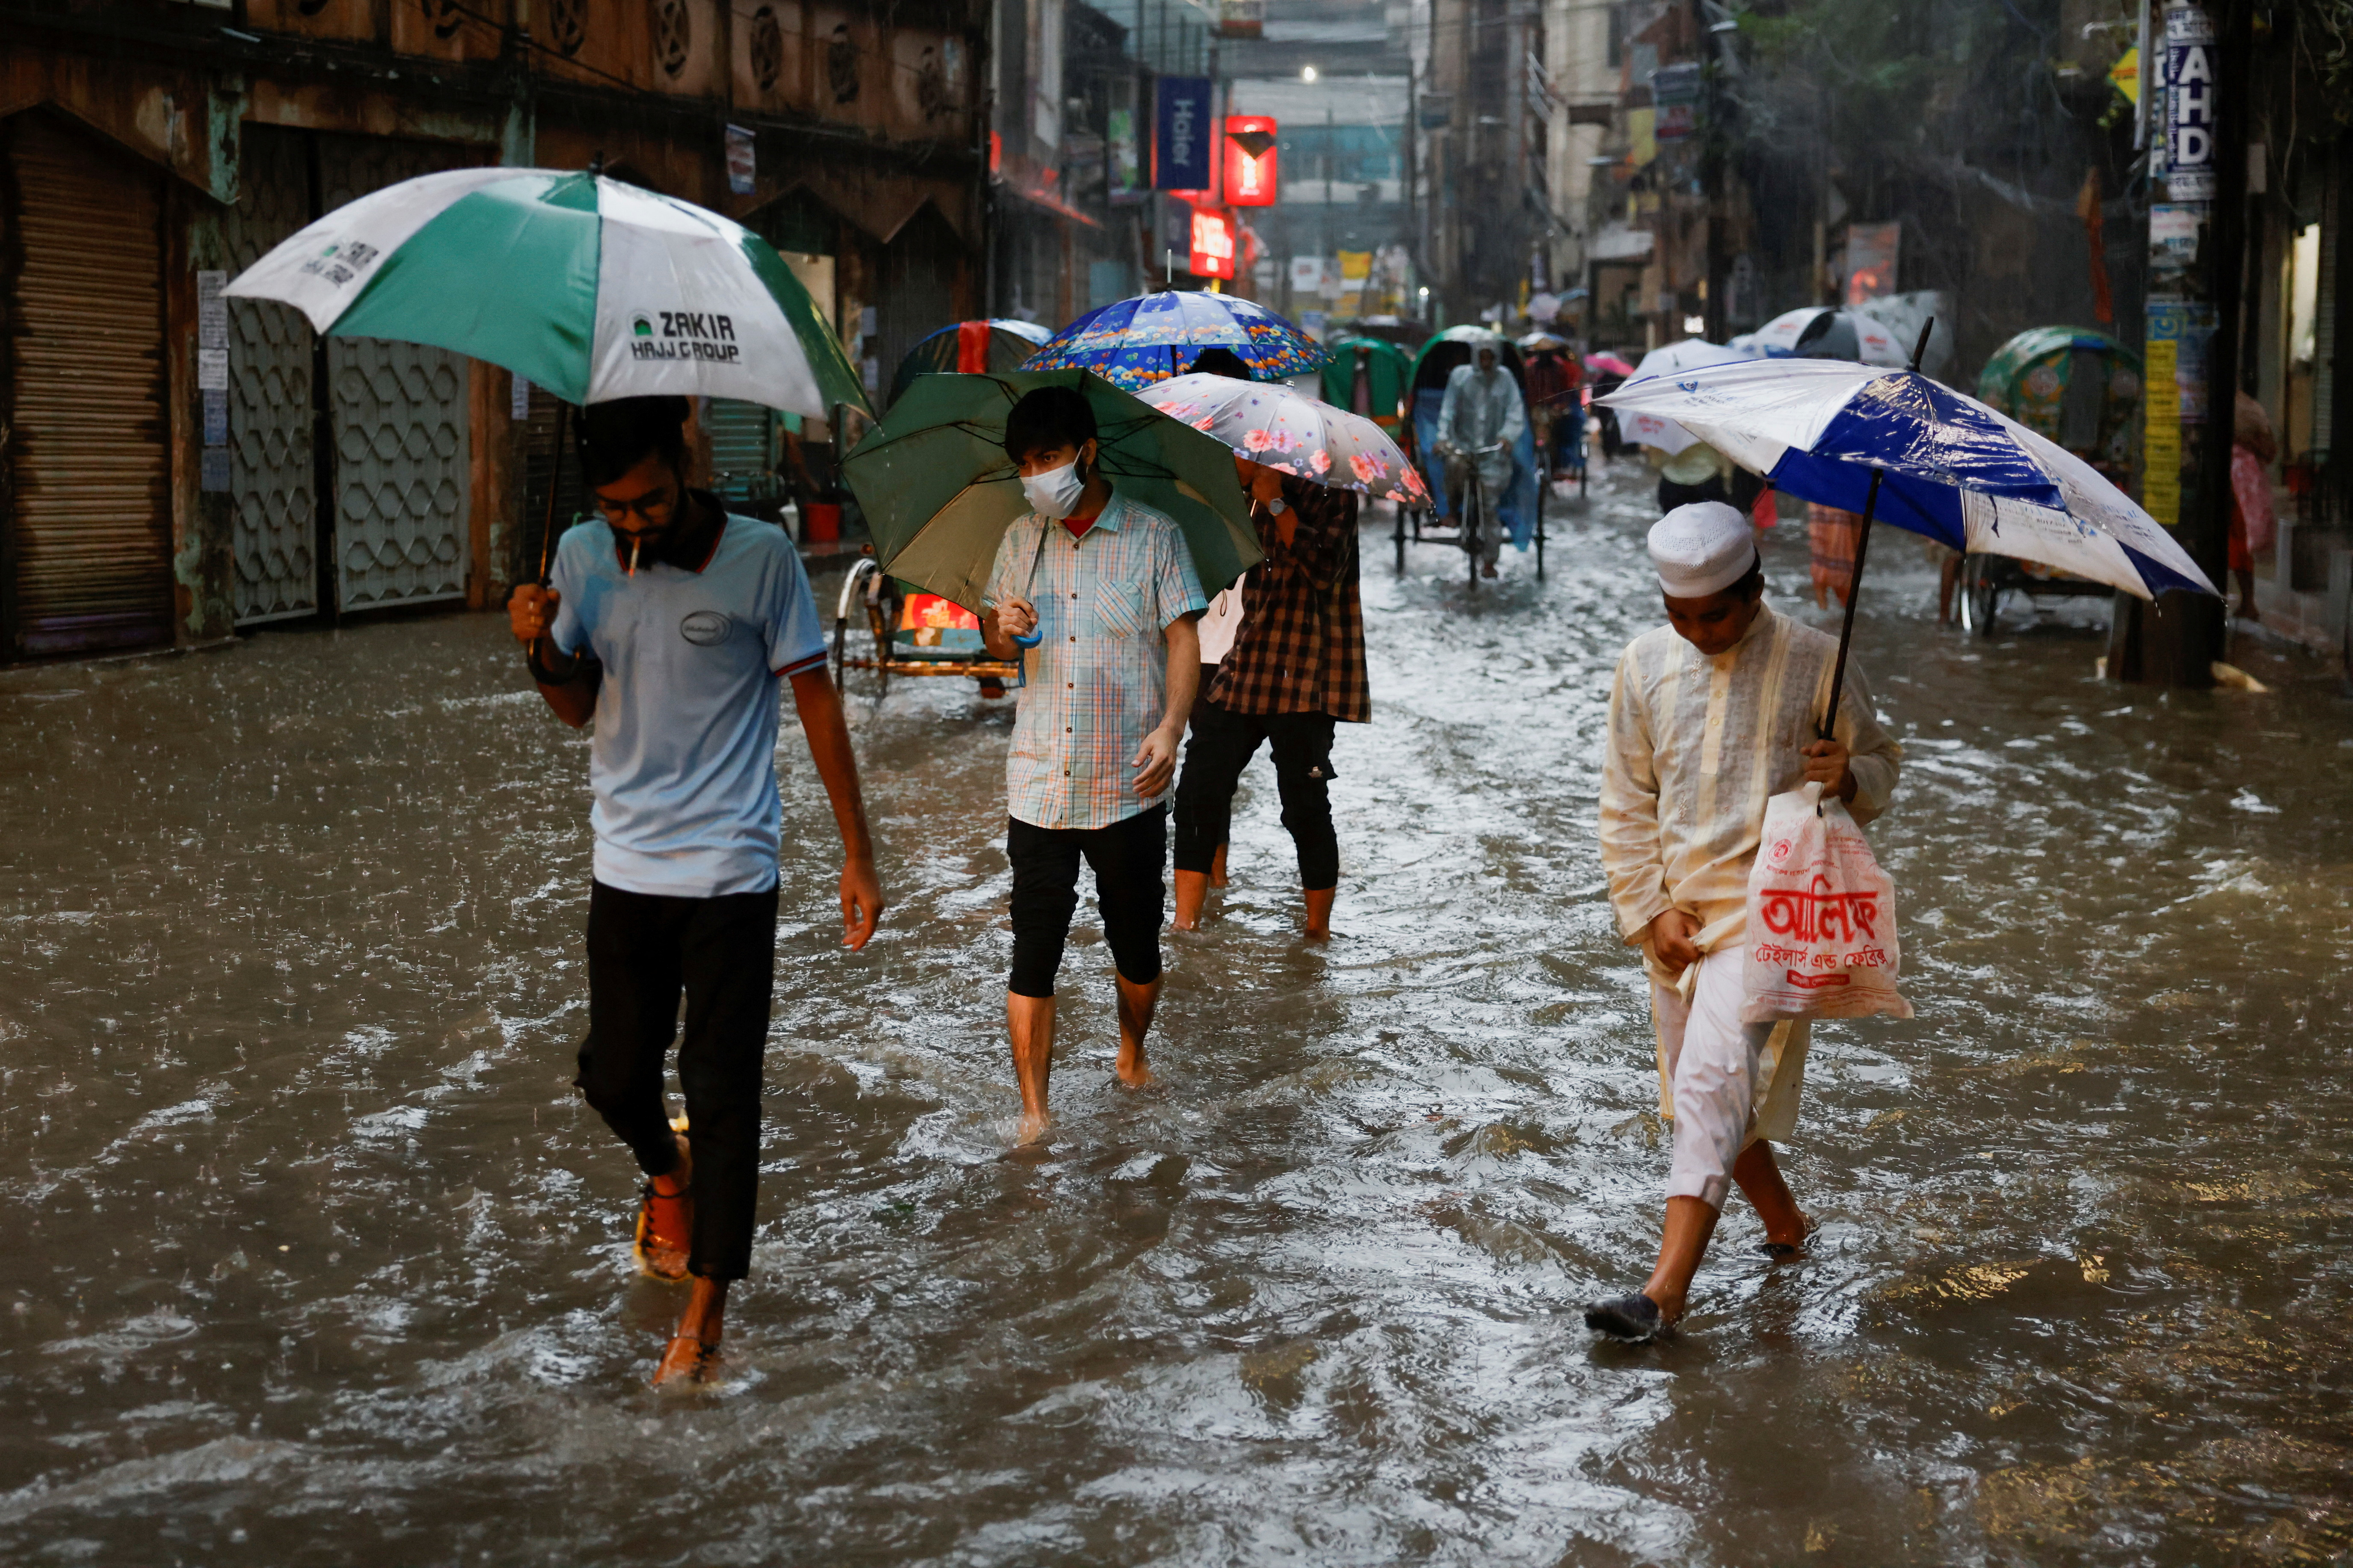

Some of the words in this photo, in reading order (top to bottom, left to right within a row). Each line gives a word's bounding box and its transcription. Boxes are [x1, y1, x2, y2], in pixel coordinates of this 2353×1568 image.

[1172, 100, 1196, 166] Haier
[659, 311, 735, 341] ZAKIR
[631, 341, 676, 359] HAJJ
[679, 341, 739, 361] GROUP
[1760, 874, 1879, 943] আলিফ
[1756, 942, 1808, 967] টেইলার্স
